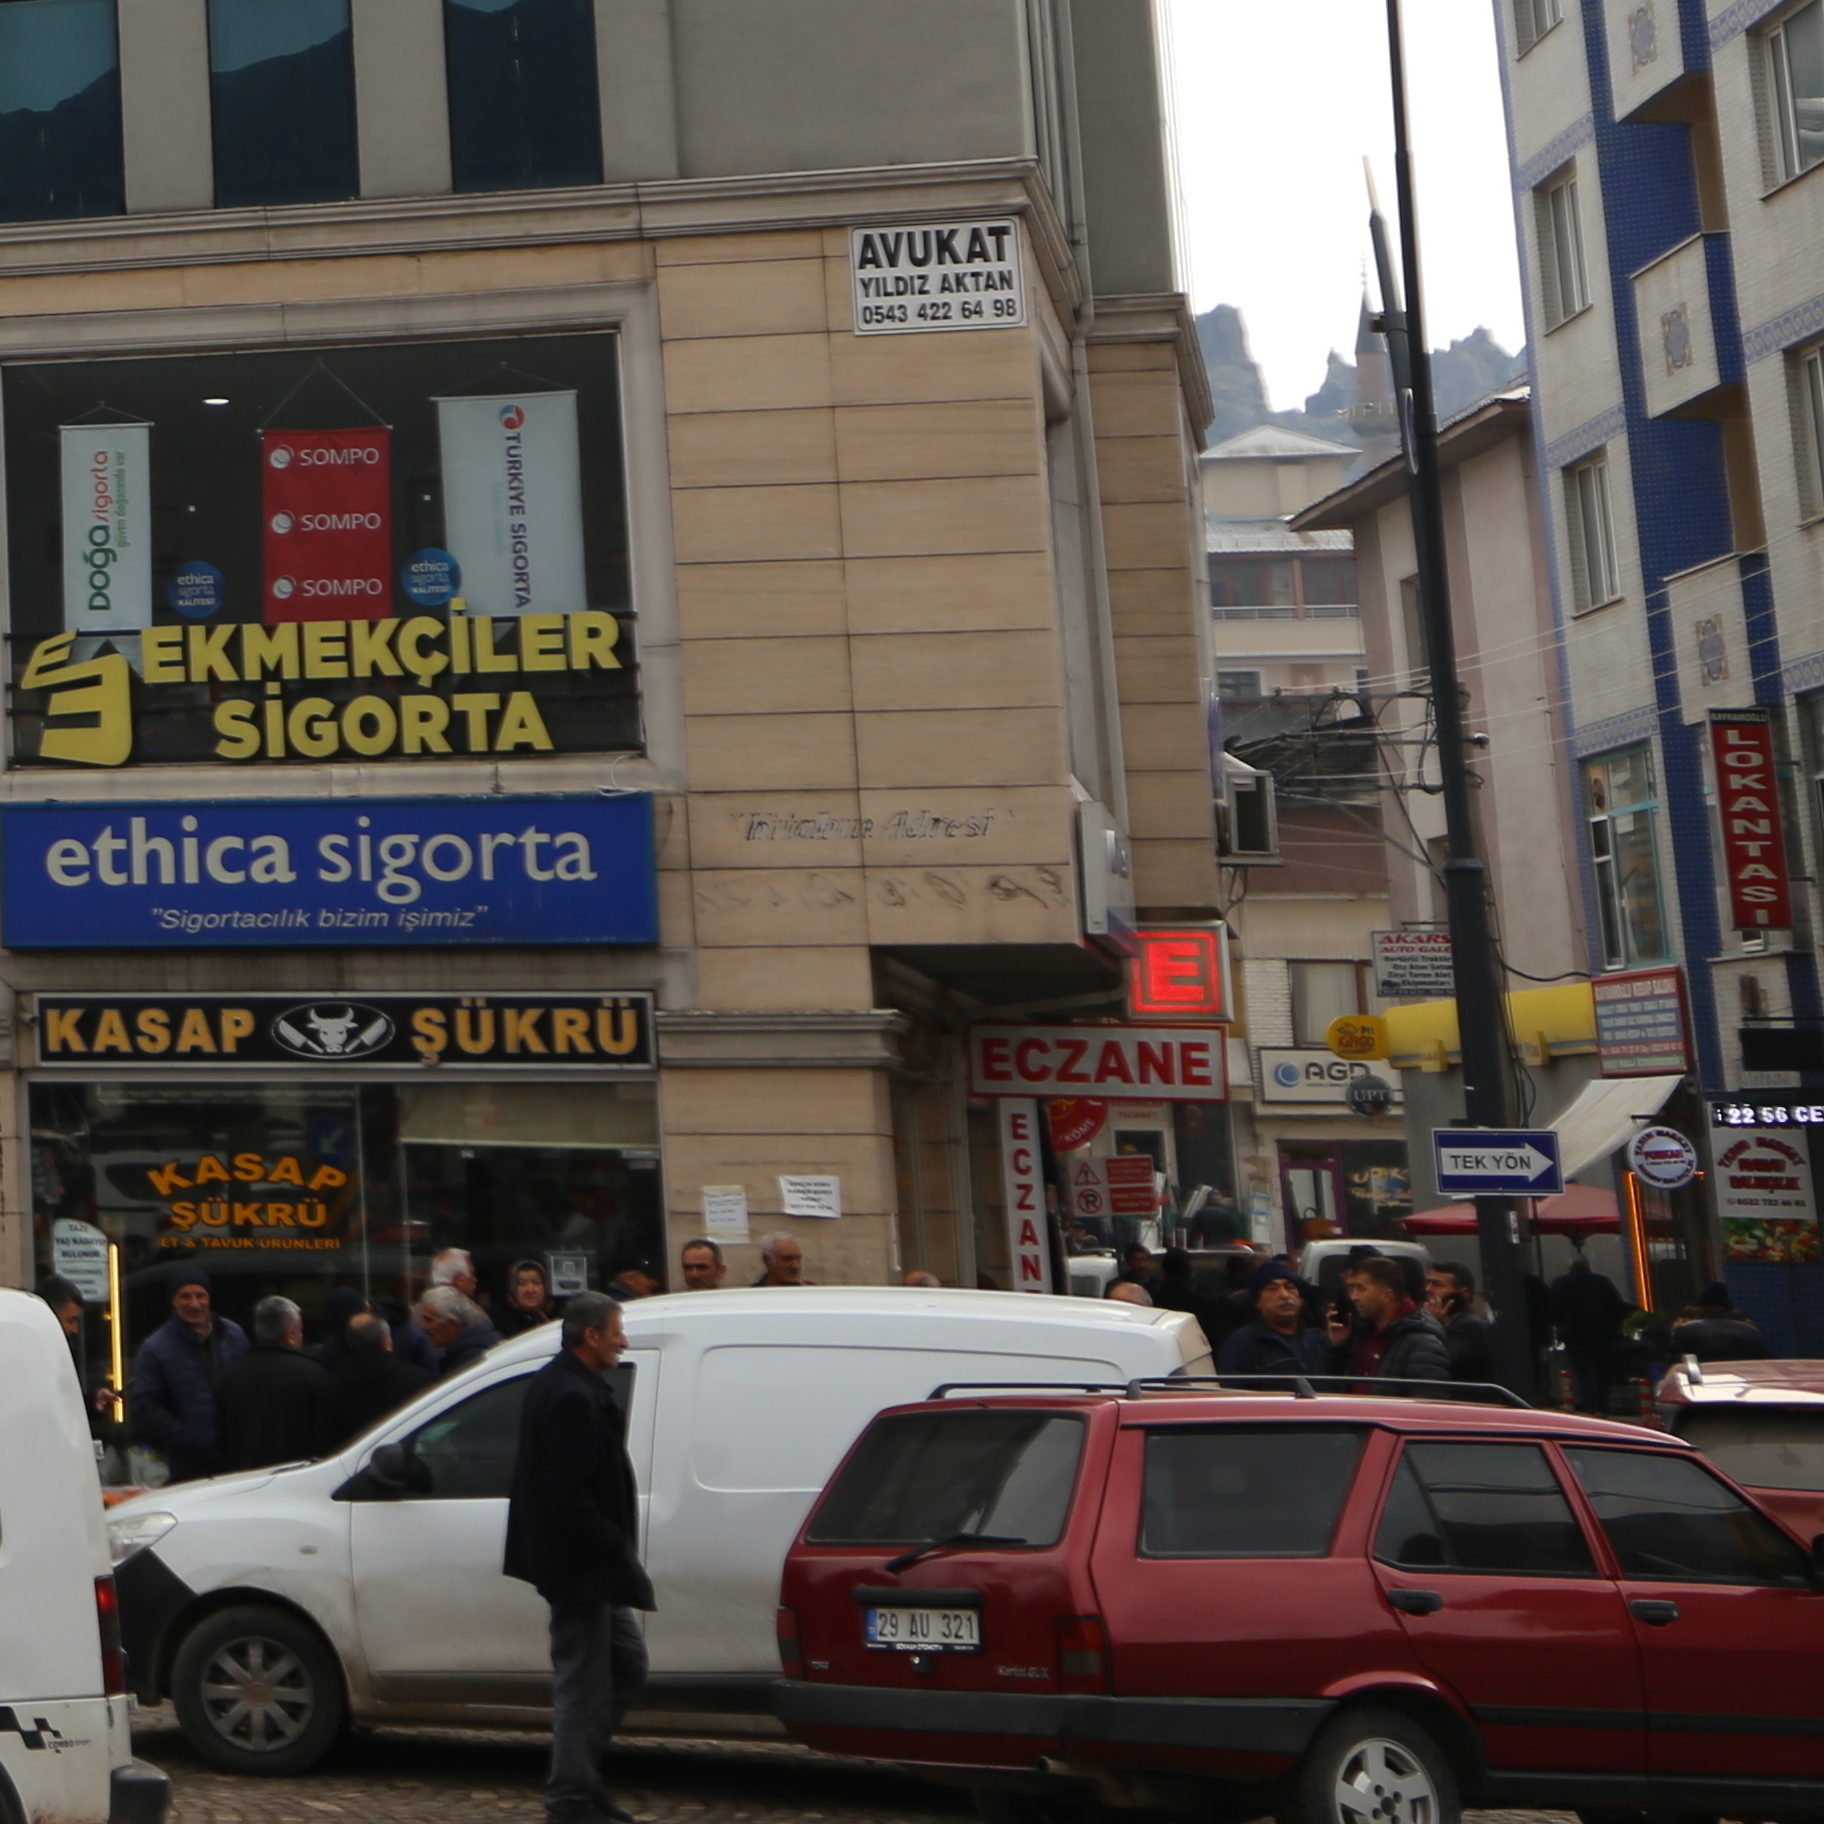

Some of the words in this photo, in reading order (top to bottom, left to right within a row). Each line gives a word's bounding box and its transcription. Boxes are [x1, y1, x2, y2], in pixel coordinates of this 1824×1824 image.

[857, 225, 1013, 270] AVUKAT
[859, 273, 931, 298] YILDIZ
[939, 269, 1014, 294] AKTAN
[862, 303, 908, 325] 0543
[917, 300, 953, 322] 422
[960, 299, 984, 320] 64
[993, 298, 1017, 318] 98
[299, 447, 380, 467] SOMPO
[300, 511, 381, 532] SOMPO
[177, 573, 215, 586] ethica
[411, 560, 449, 573] ethica
[302, 577, 383, 597] SOMPO
[140, 596, 623, 687] EKMEKÇİLER
[213, 682, 555, 760] SİGORTA
[1724, 729, 1778, 925] LOKANTASI
[45, 816, 297, 887] ethica
[317, 816, 598, 905] sigorta
[318, 906, 389, 927] bizim
[1379, 933, 1453, 944] AKARS
[1145, 941, 1205, 1003] E
[46, 1008, 256, 1056] KASAP
[410, 998, 640, 1067] ŞÜKRÜ
[981, 1037, 1213, 1087] ECZANE
[1353, 1089, 1389, 1102] UPT
[147, 1152, 348, 1197] KASAP
[1450, 1154, 1488, 1170] TEK
[1492, 1151, 1533, 1170] YÖN
[170, 1196, 328, 1233] ŞÜKRÜ
[1010, 1112, 1044, 1293] ECZAN
[160, 1238, 180, 1249] ET
[202, 1237, 255, 1249] TAVUK
[260, 1236, 341, 1250] ÜRÜNLERİ
[878, 1612, 899, 1638] 29
[909, 1613, 930, 1639] AU
[941, 1613, 975, 1639] 321
